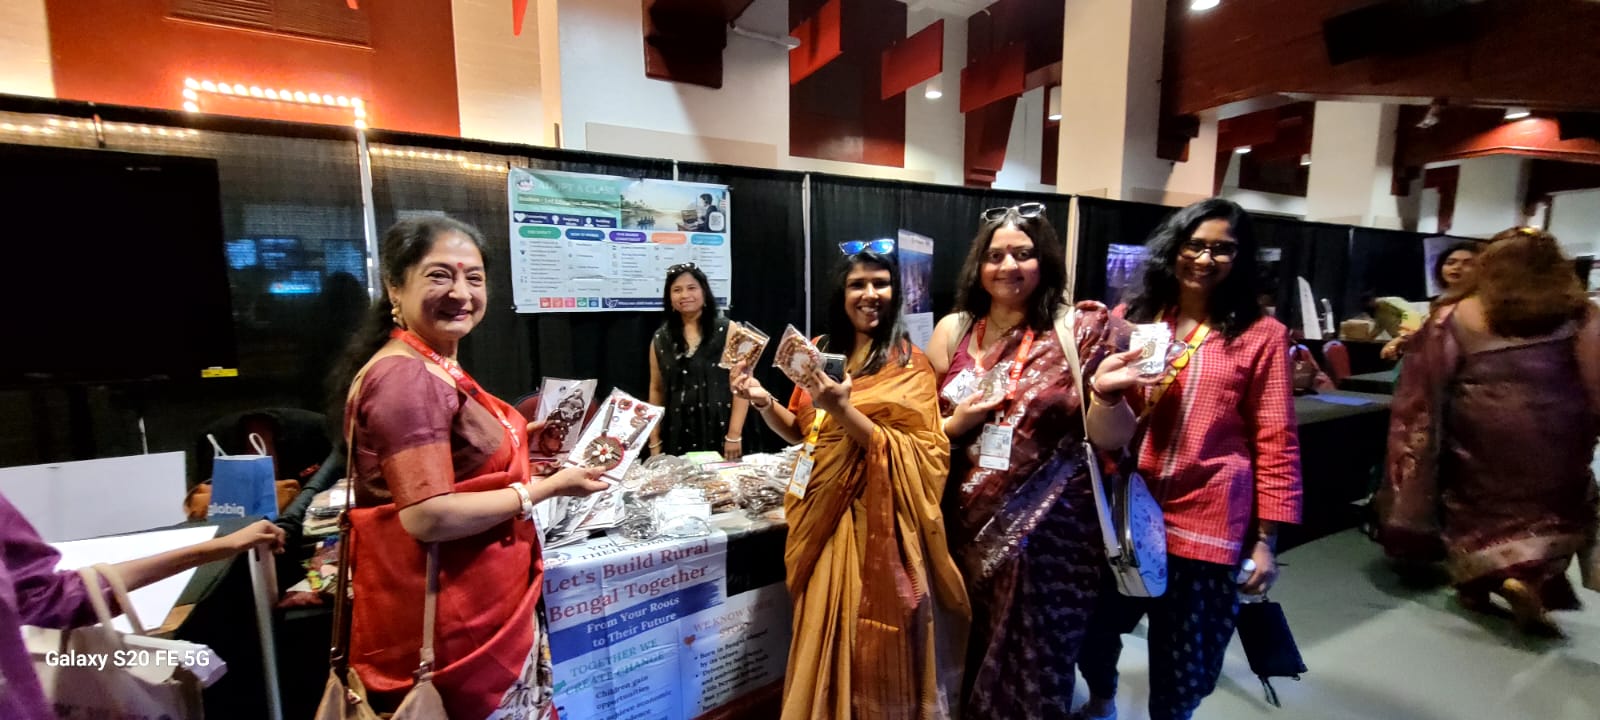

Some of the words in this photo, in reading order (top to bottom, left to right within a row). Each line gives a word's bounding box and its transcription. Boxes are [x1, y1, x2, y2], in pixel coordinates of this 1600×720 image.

[545, 570, 596, 595] Let's
[603, 554, 654, 579] Build
[661, 542, 709, 564] Rural
[550, 588, 618, 622] Bengal
[624, 565, 708, 598] Together
[586, 618, 618, 634] From
[620, 606, 648, 622] Your
[650, 596, 680, 612] Roots
[592, 637, 606, 648] to
[608, 624, 639, 644] Their
[640, 612, 677, 631] Future
[570, 646, 637, 677] TOGETHER
[595, 682, 631, 698] Children
[632, 675, 649, 689] gain
[596, 686, 650, 710] opportunities
